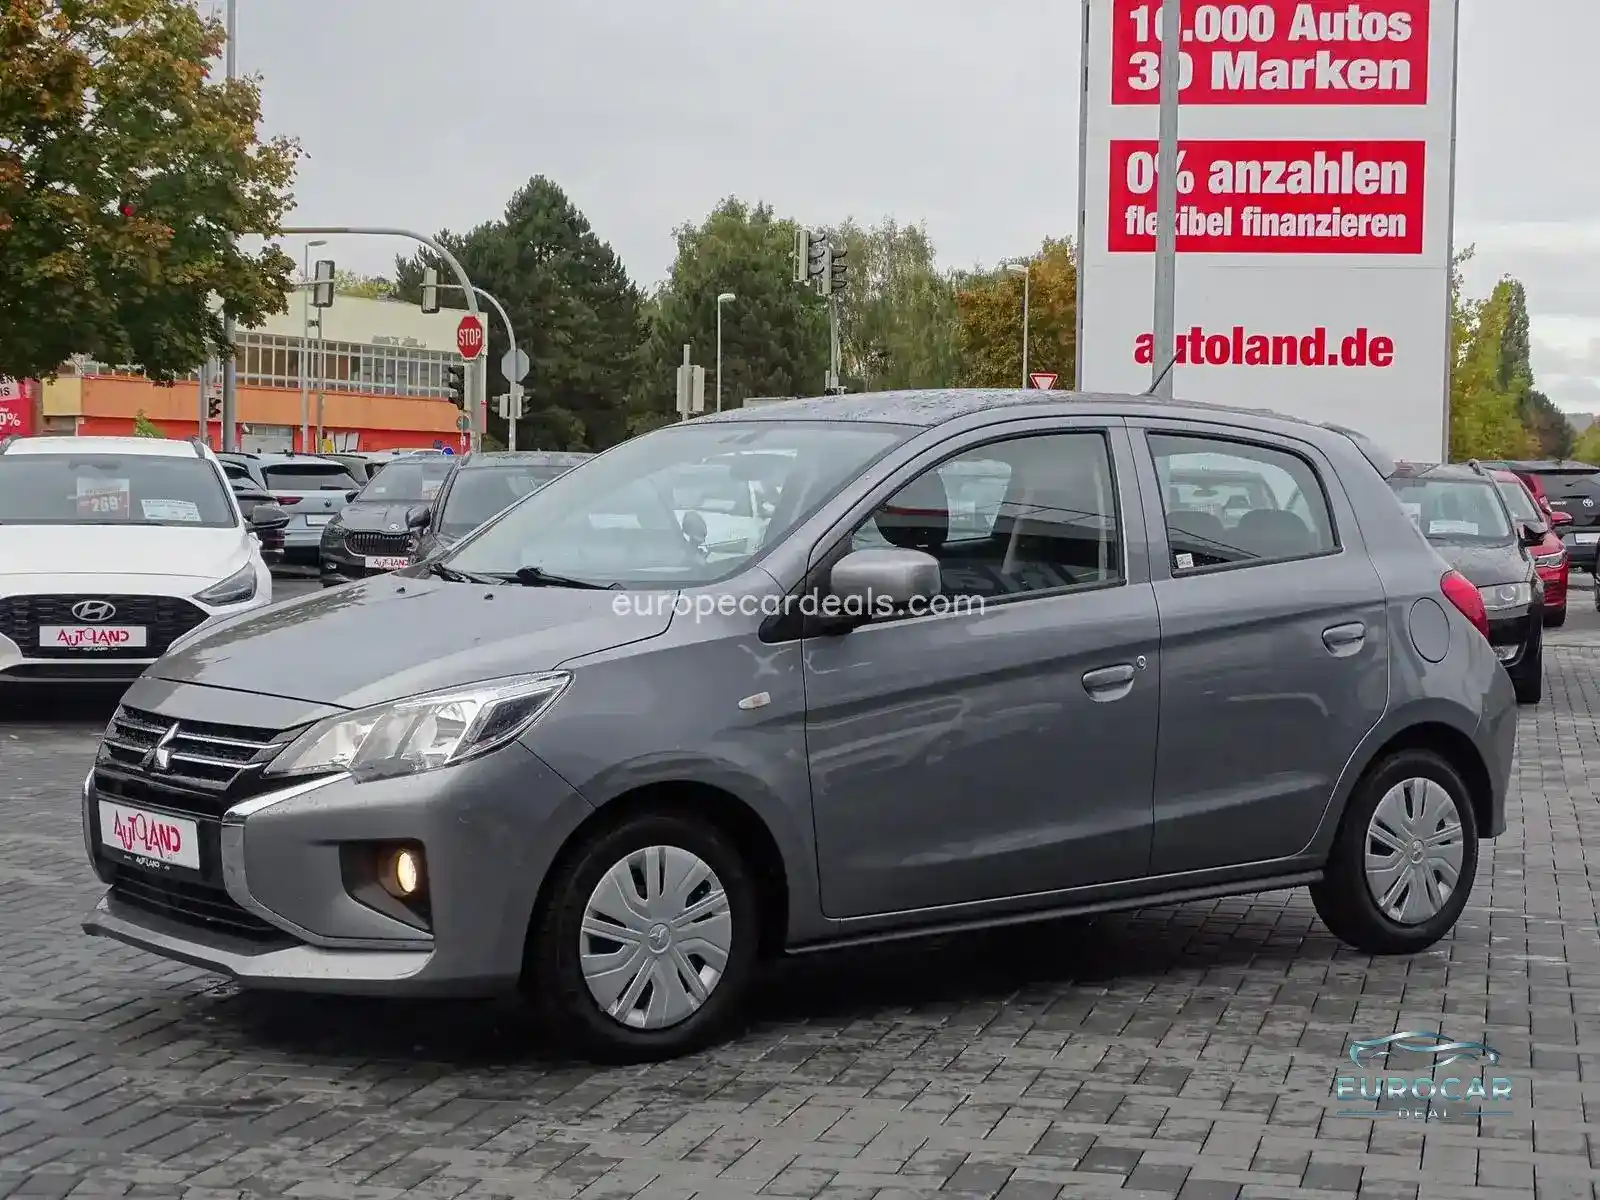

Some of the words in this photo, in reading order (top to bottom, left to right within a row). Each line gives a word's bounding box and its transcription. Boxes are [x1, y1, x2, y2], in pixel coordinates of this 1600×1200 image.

[1288, 4, 1412, 42] Autos
[1211, 50, 1411, 91] Marken
[1207, 151, 1407, 195] anzahlen
[1240, 206, 1407, 238] finanzieren
[459, 328, 481, 346] STOP
[57, 627, 130, 646] AUTOLAND
[114, 809, 182, 858] AUTOLAND
